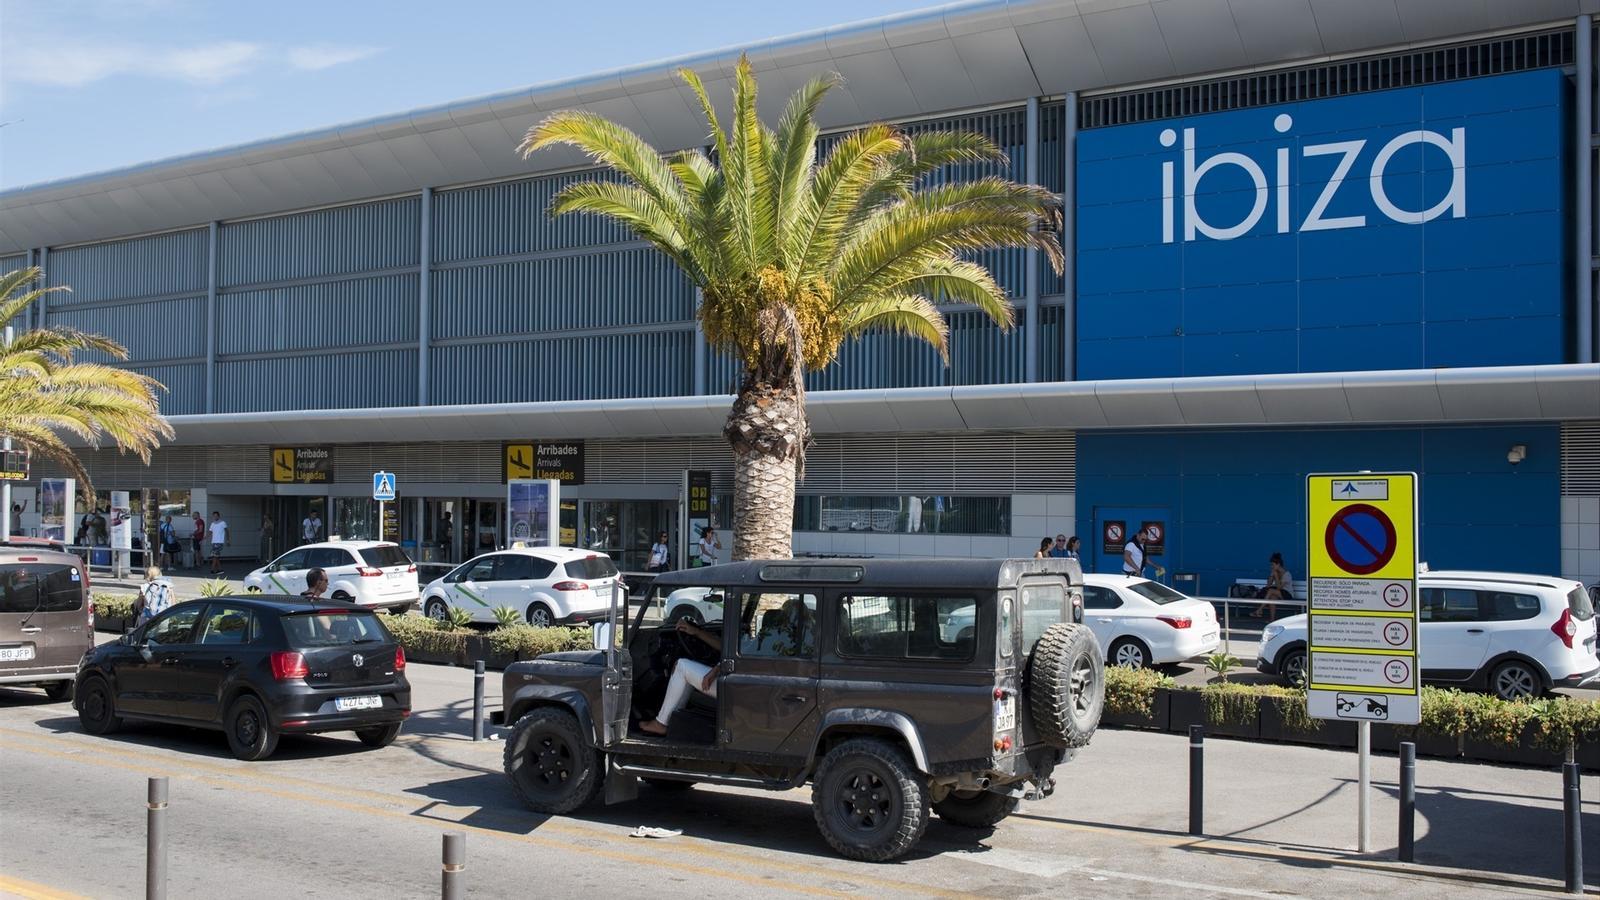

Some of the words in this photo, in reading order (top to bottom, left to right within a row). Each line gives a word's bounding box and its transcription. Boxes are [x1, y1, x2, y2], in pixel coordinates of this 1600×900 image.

[1159, 113, 1465, 244] ibiza
[296, 447, 328, 458] Arribades
[537, 444, 578, 455] Arribades
[296, 461, 316, 469] Arrivals
[537, 458, 561, 467] Arrivals
[296, 471, 326, 483] Llegadas
[536, 469, 574, 480] Llegadas
[15, 649, 30, 658] JFP
[343, 696, 363, 707] 4274
